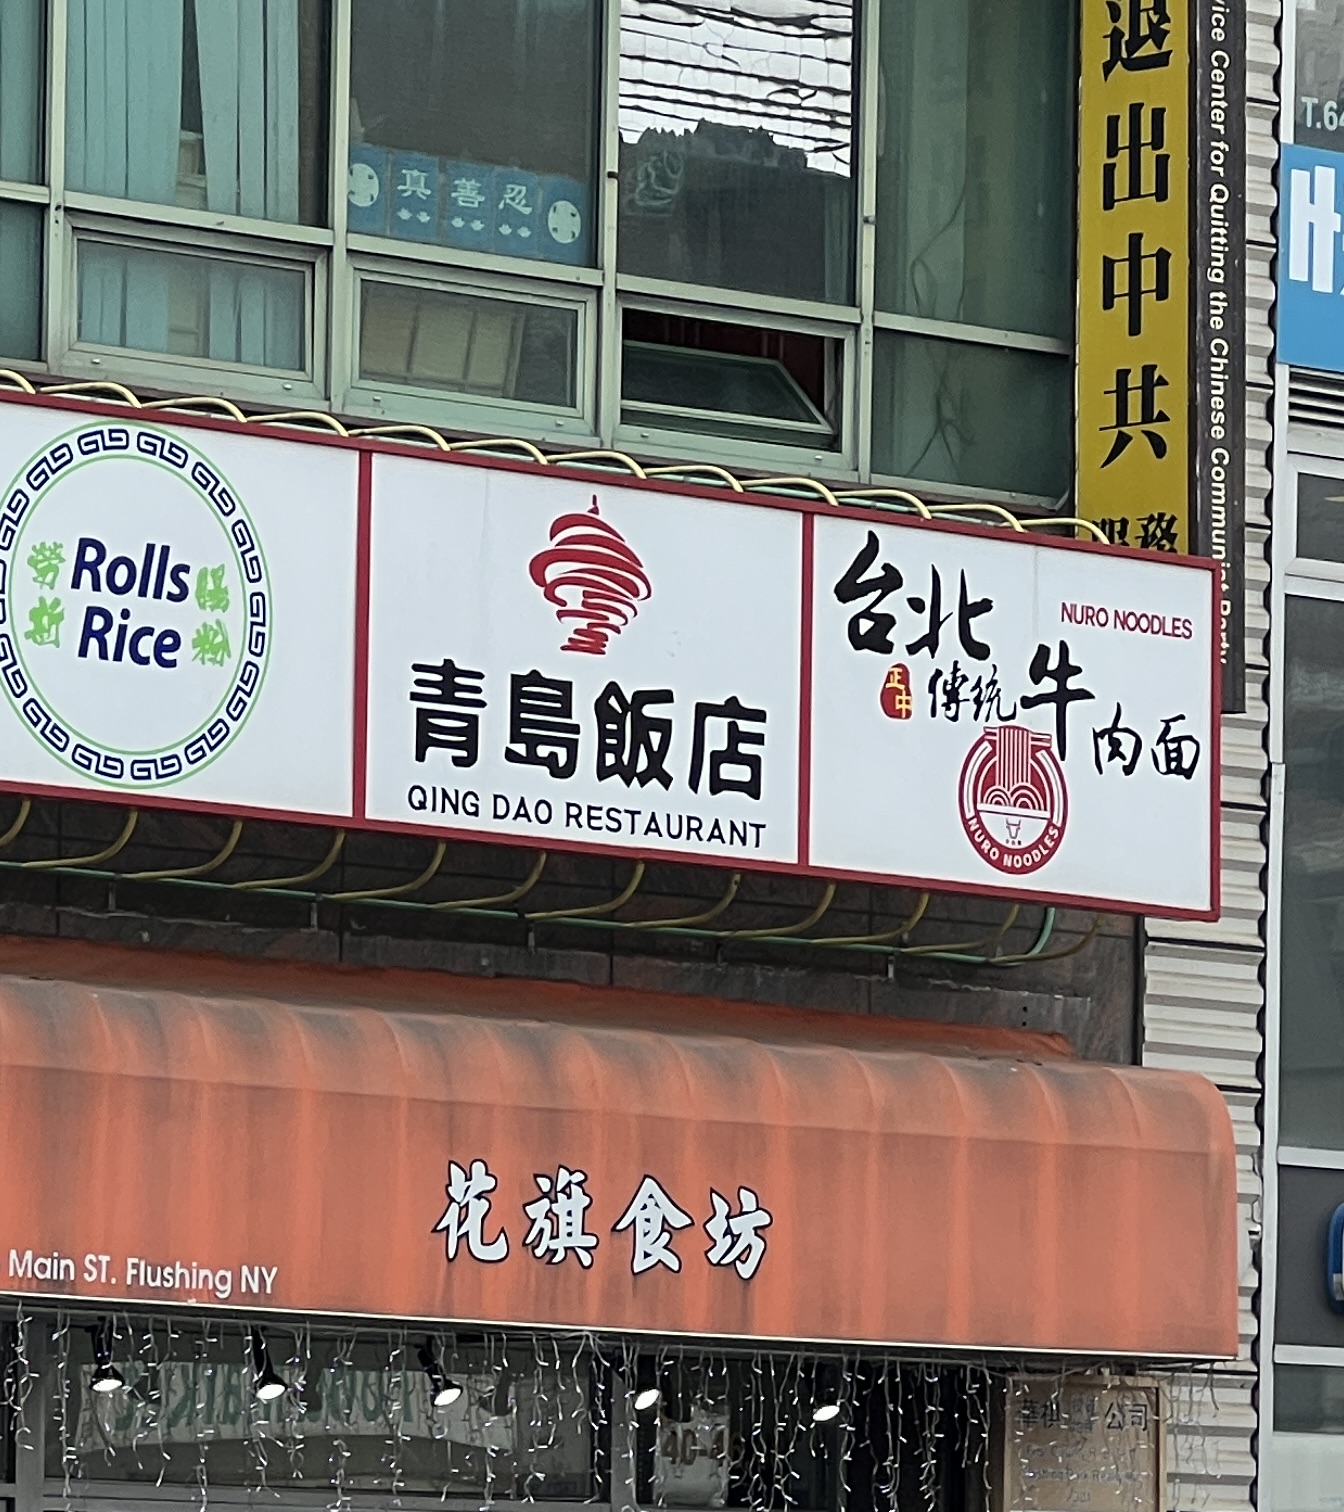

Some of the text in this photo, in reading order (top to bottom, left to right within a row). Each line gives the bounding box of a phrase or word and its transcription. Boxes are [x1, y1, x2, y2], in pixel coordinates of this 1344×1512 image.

[396, 168, 534, 215] 真善忍
[1099, 0, 1173, 468] 退出中共
[1207, 50, 1230, 440] Center for Quitting the Chinese
[70, 537, 191, 603] Rolls
[834, 530, 994, 661] 台北
[77, 605, 182, 669] Rice
[1061, 602, 1109, 628] NURO
[1114, 608, 1193, 640] NOODLES
[409, 658, 767, 801] 青島飯店
[407, 784, 767, 849] QING DAO RESTAURANT
[967, 816, 1060, 869] NURO NOODLES
[432, 1158, 774, 1282] 花旗食坊
[9, 1249, 76, 1282] Main
[83, 1254, 117, 1285] ST.
[125, 1257, 234, 1299] Flushing
[240, 1266, 279, 1295] NY
